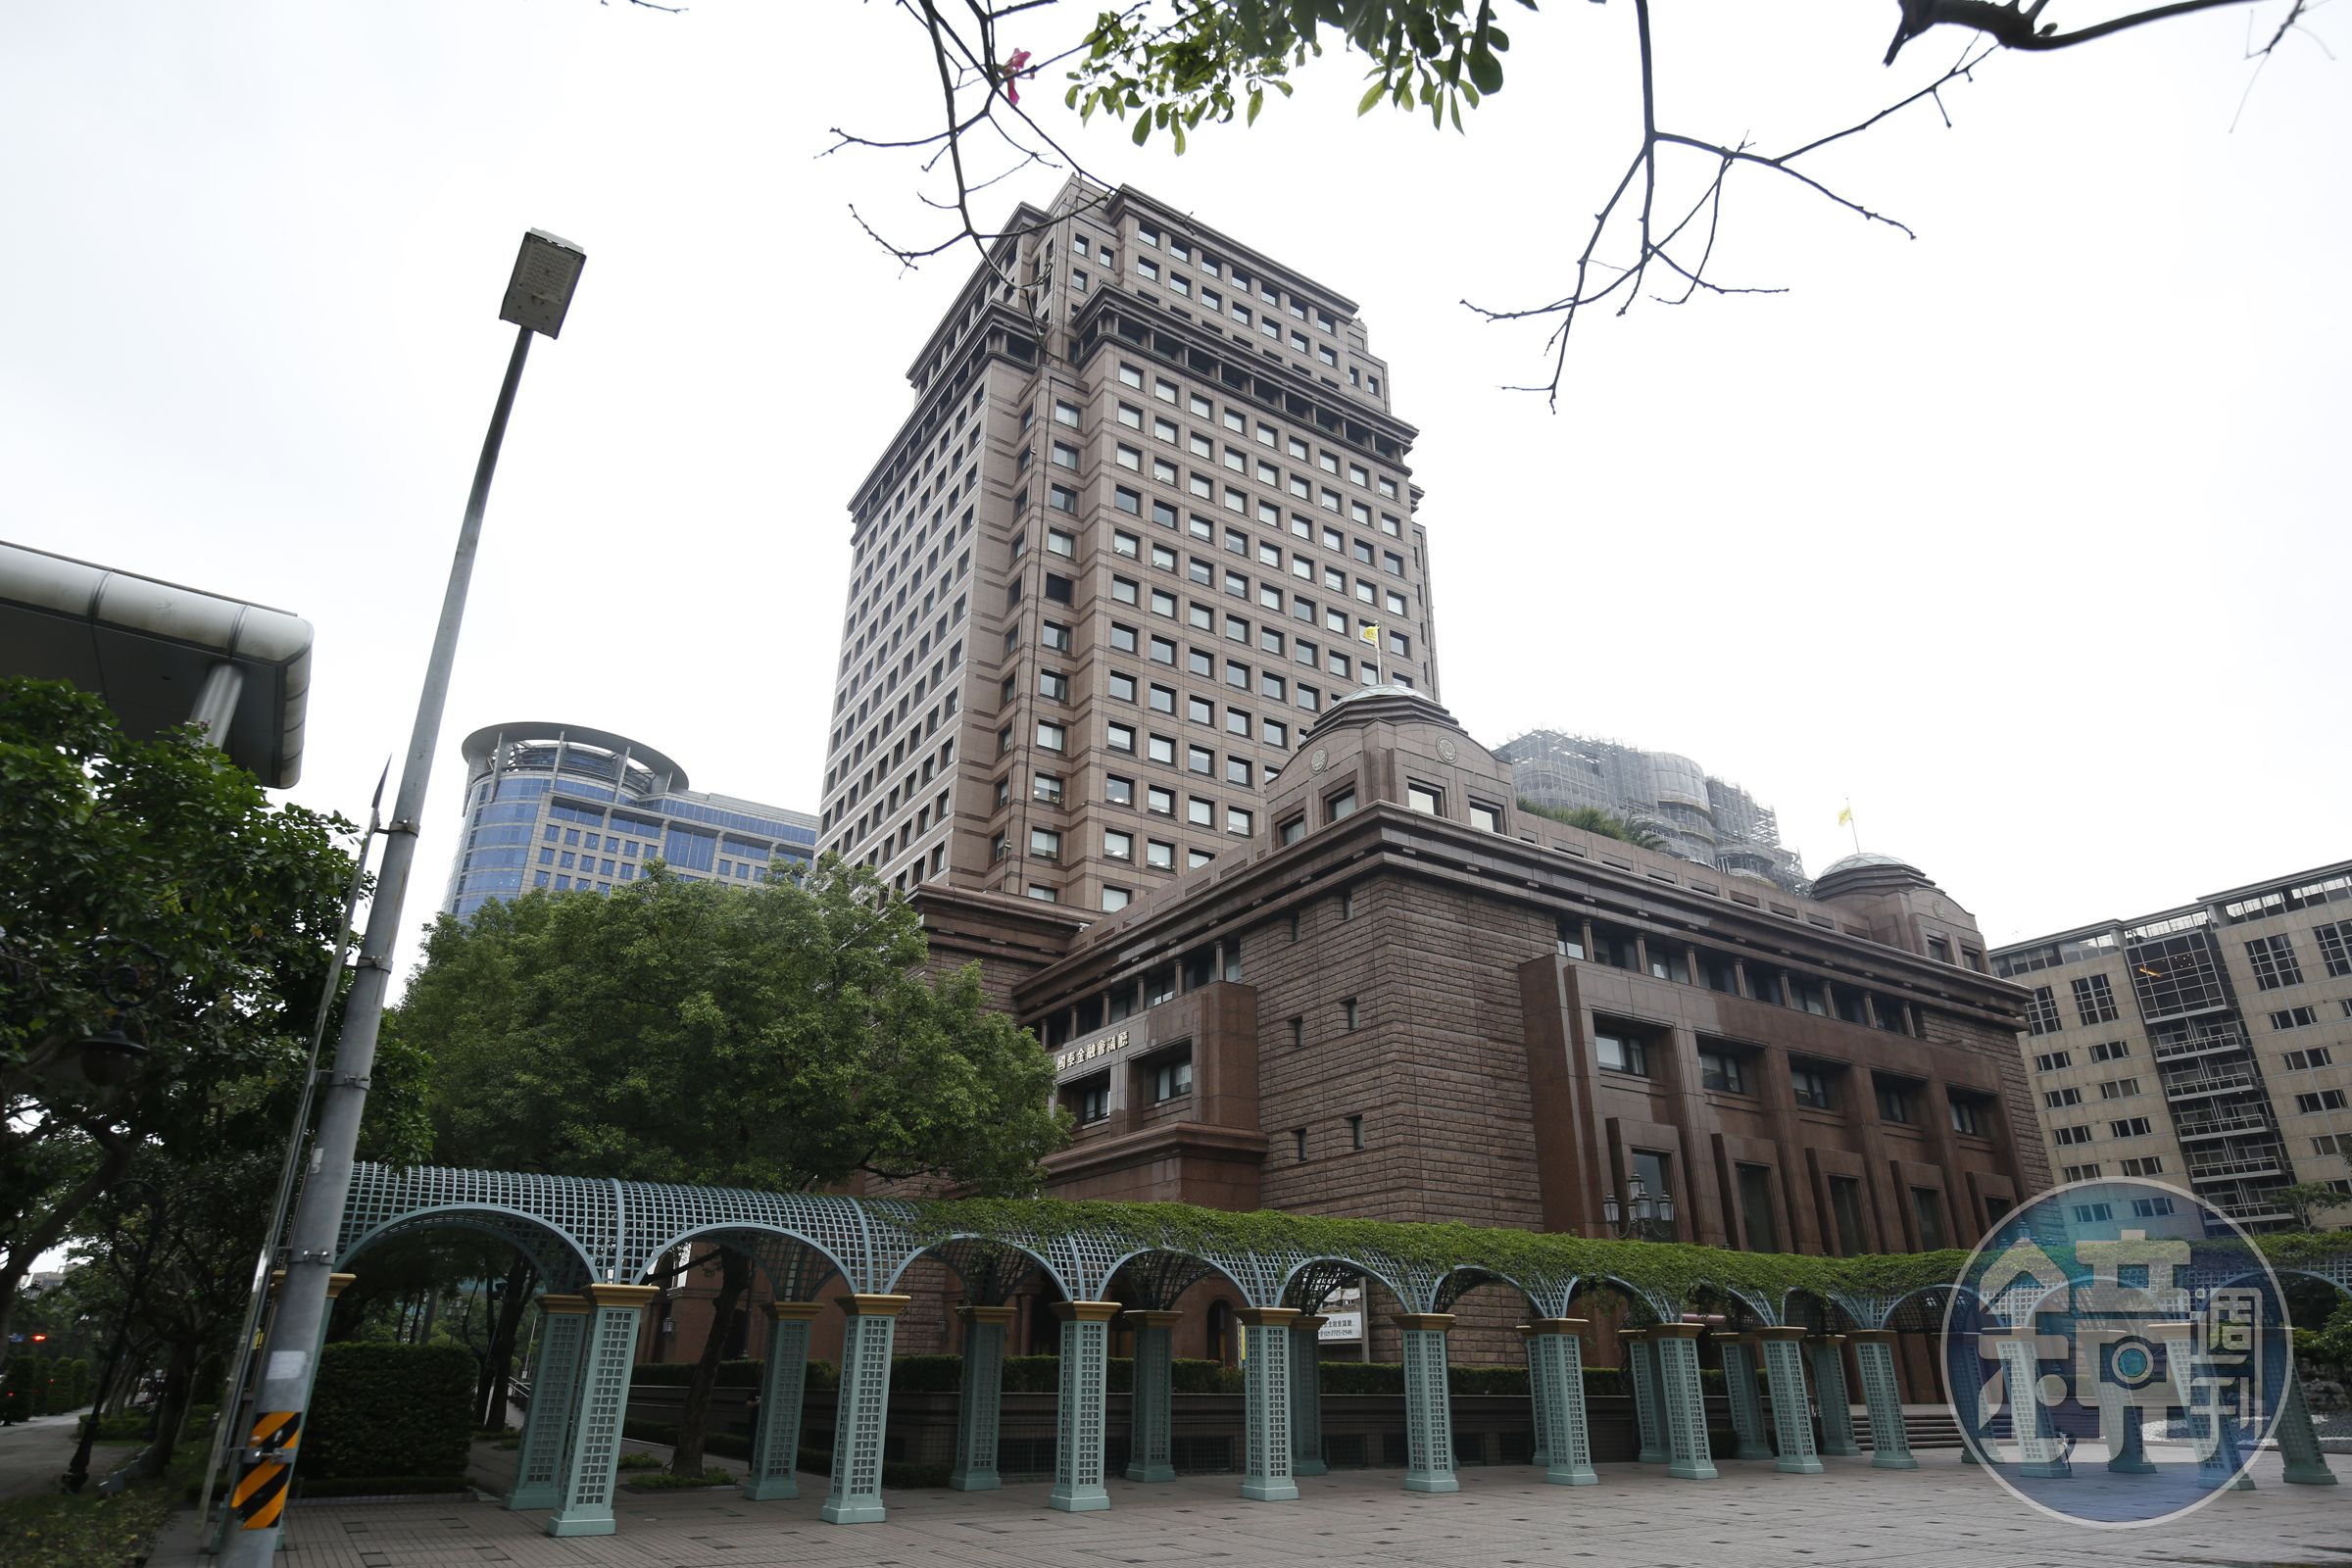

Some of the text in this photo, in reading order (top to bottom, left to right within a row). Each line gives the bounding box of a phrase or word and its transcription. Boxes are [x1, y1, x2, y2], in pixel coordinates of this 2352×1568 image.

[1056, 1030, 1130, 1071] 國泰金融會議廳
